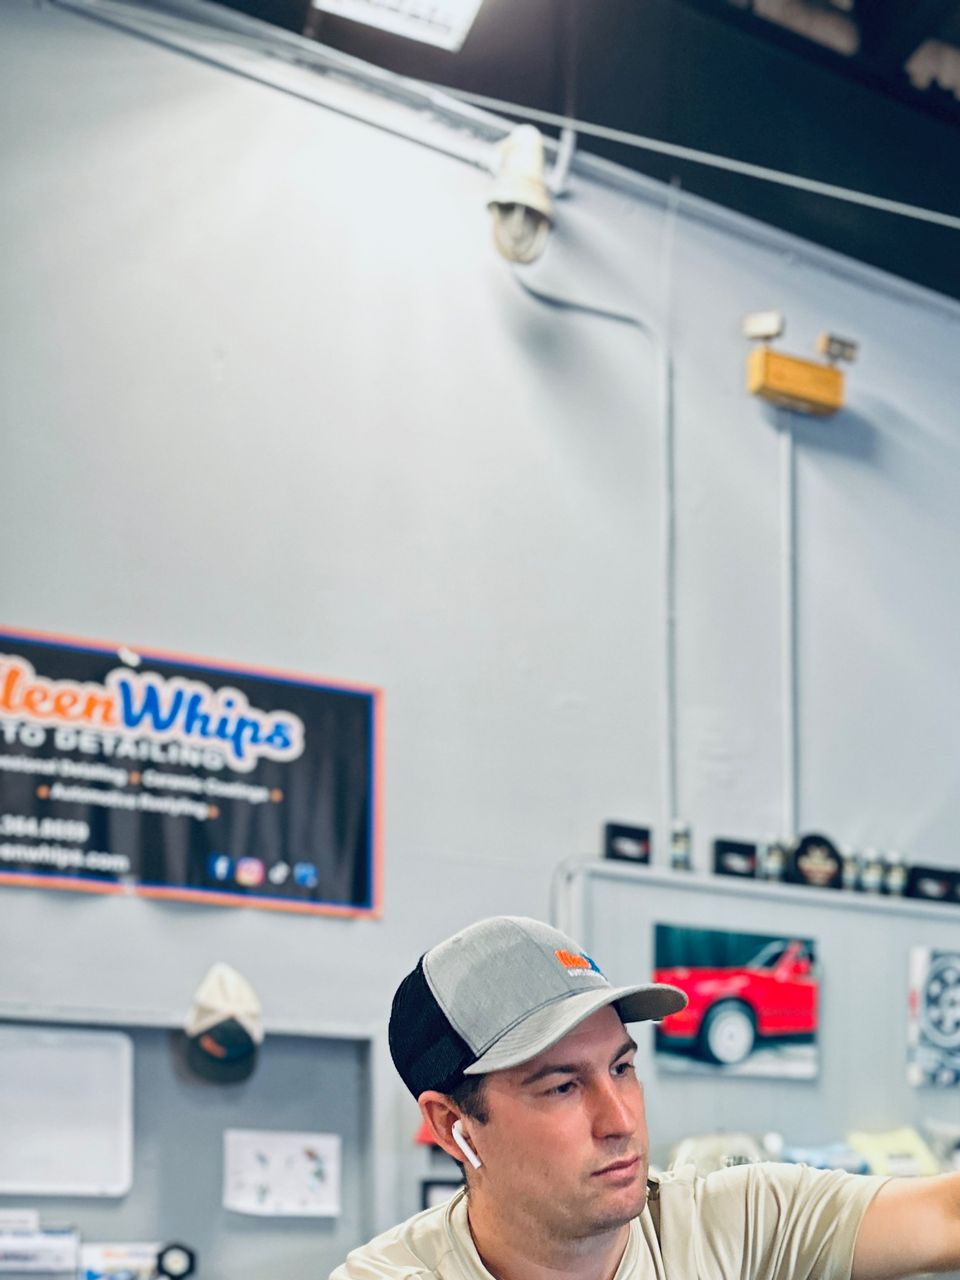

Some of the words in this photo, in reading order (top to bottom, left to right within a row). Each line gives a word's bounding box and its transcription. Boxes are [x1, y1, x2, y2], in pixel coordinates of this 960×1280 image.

[0, 661, 297, 765] leenWhips
[1, 719, 47, 748] TO
[54, 727, 225, 771] DETAILING
